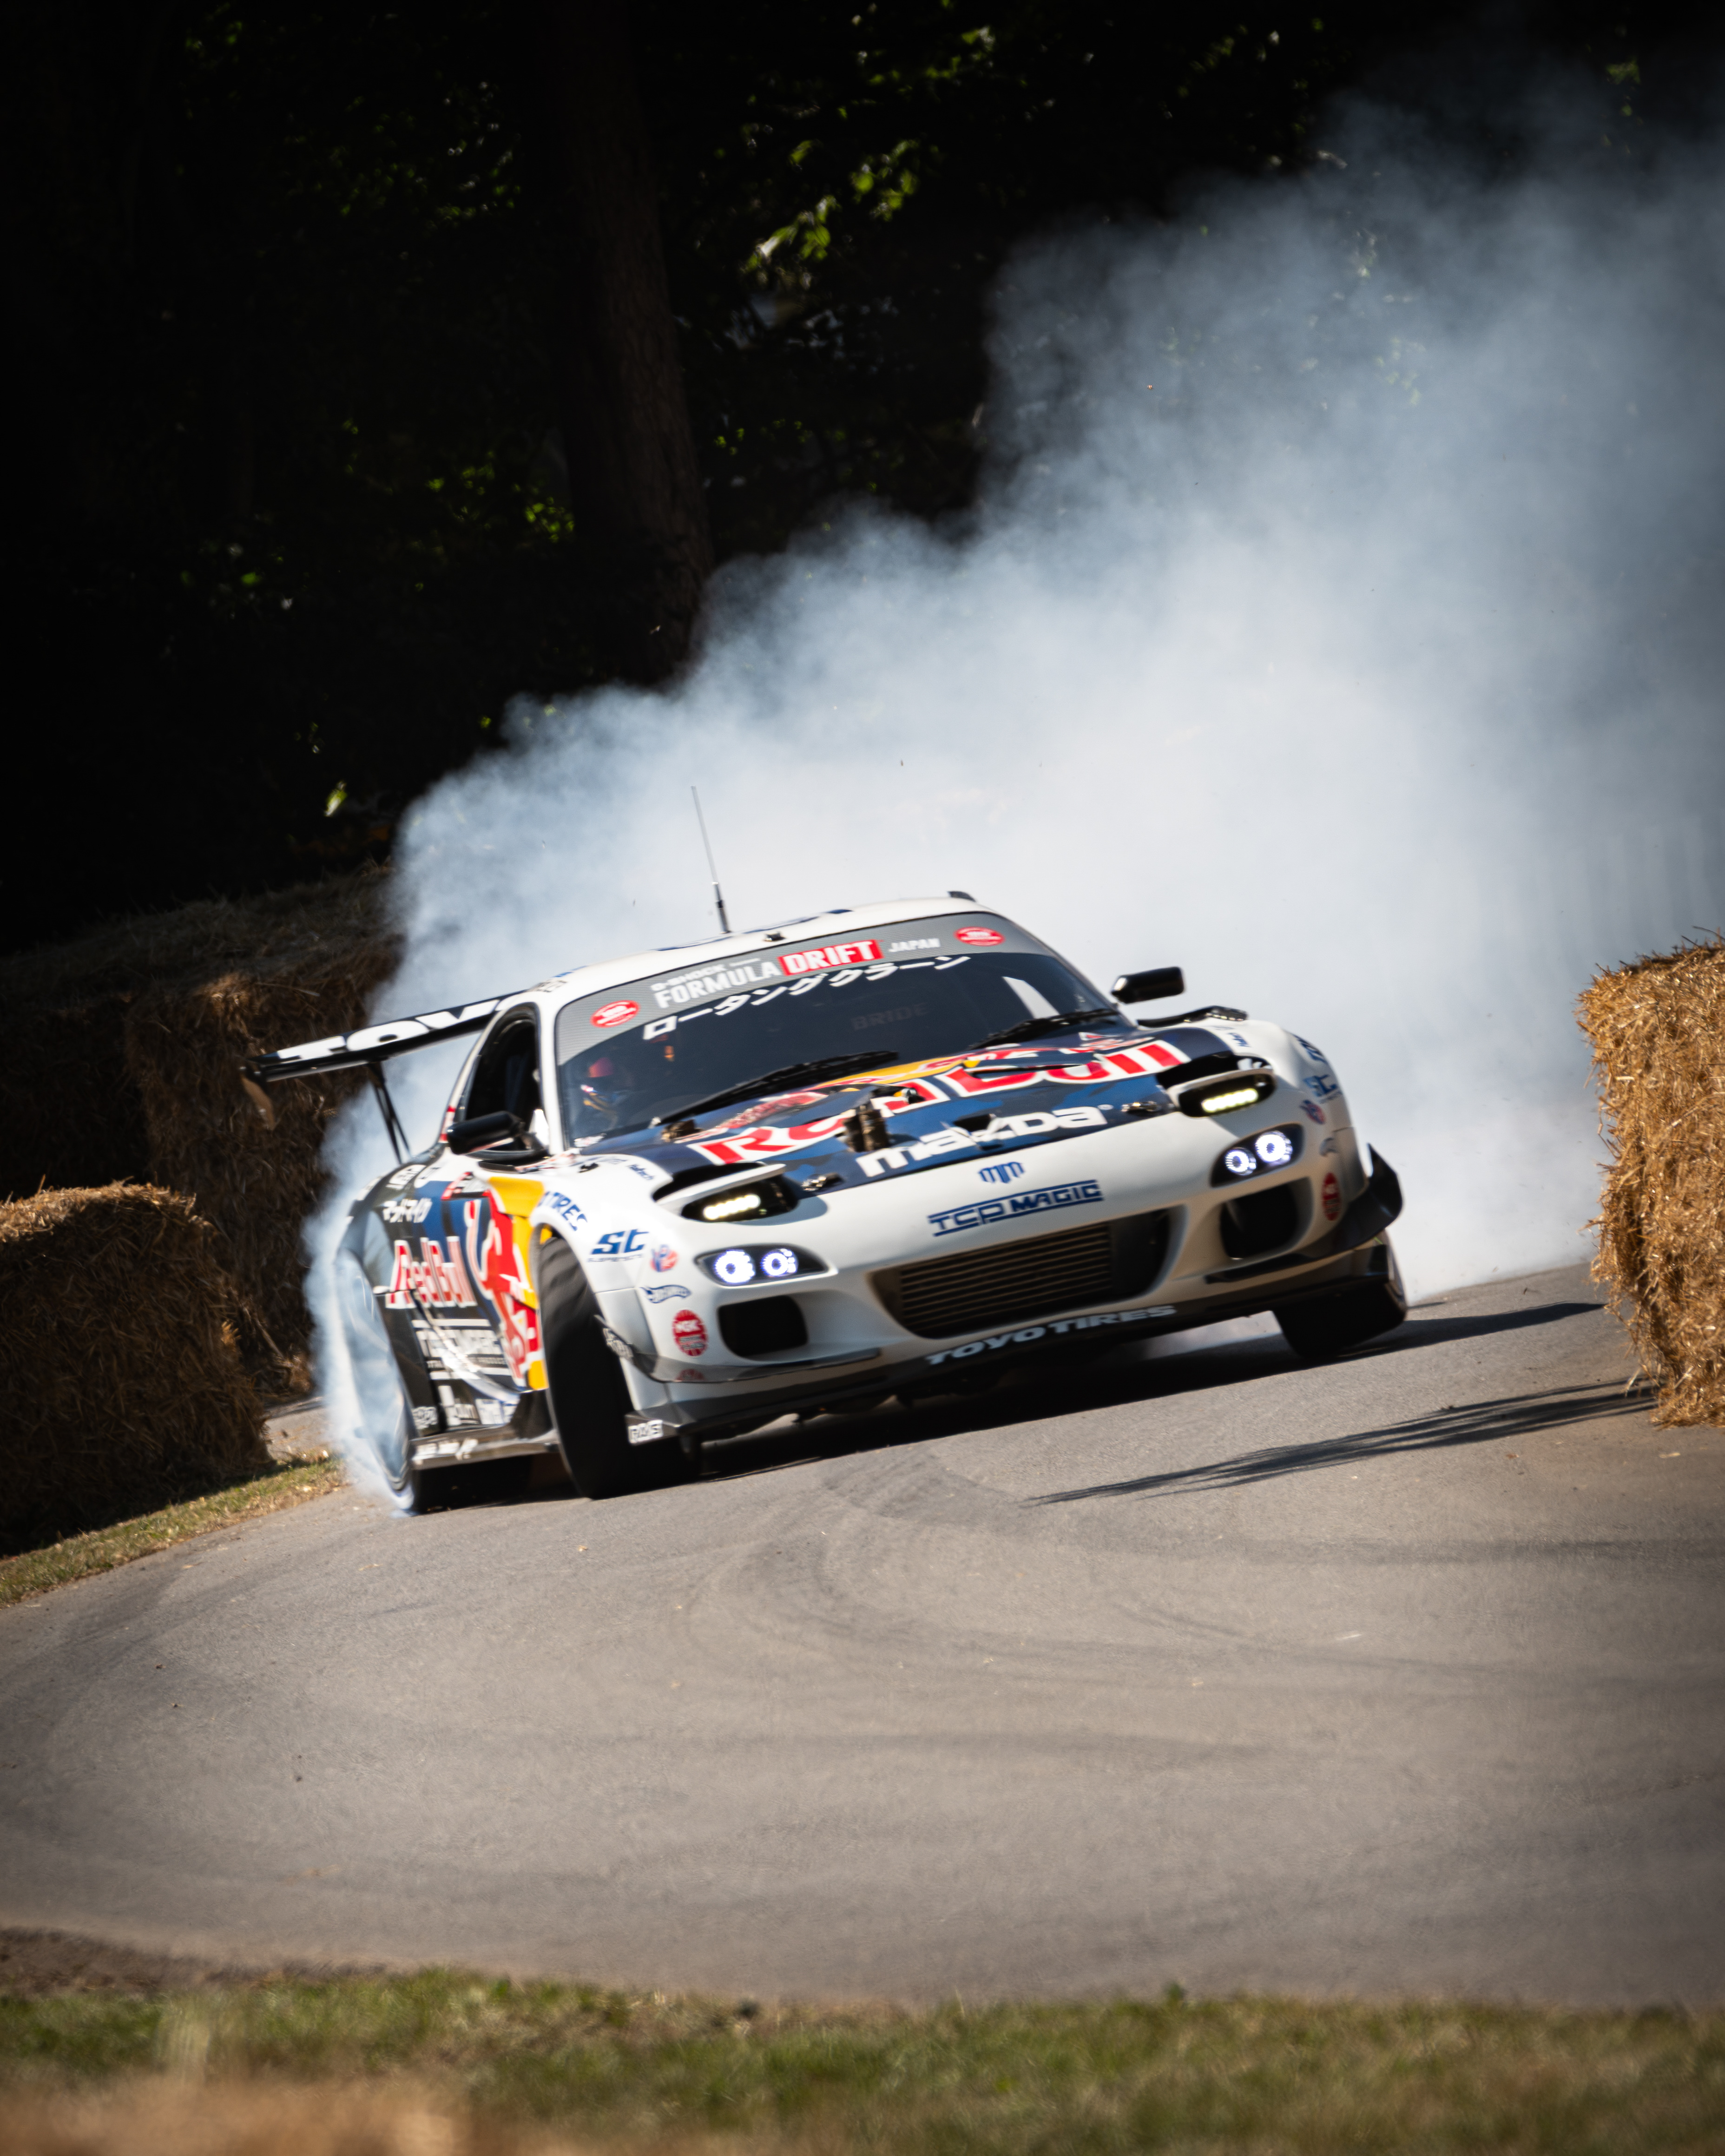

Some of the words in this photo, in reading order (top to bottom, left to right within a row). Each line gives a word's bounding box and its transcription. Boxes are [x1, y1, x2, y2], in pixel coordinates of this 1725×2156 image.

[888, 938, 941, 953] JAPAN
[653, 960, 783, 1009] FORMULA
[783, 940, 876, 975] DRIFT
[853, 1002, 928, 1031] BRIDE
[930, 1203, 1008, 1230] TCP
[1011, 1182, 1103, 1217] MAGIC
[926, 1327, 1046, 1365] TOYO
[1049, 1304, 1178, 1334] TIRES
